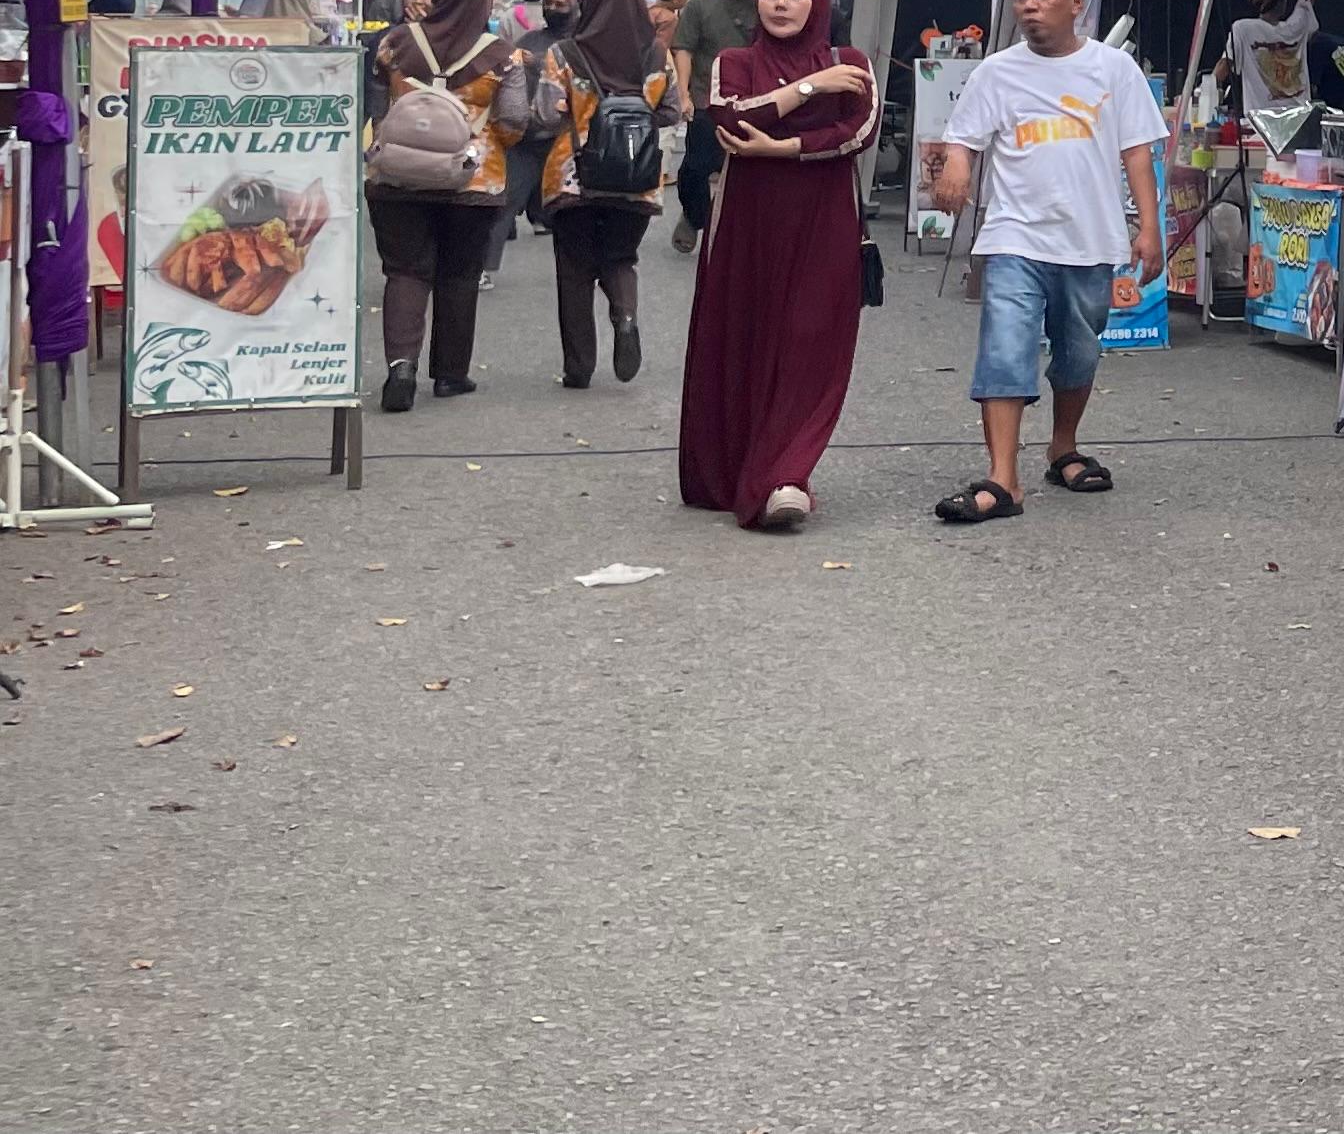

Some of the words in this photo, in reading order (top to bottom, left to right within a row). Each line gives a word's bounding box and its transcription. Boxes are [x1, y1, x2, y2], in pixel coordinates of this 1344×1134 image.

[143, 94, 353, 127] PEMPEK
[144, 132, 241, 154] IKAN
[246, 130, 350, 153] LAUT
[236, 343, 289, 358] Kapal
[292, 341, 346, 353] Selam
[290, 357, 347, 370] Lenjer
